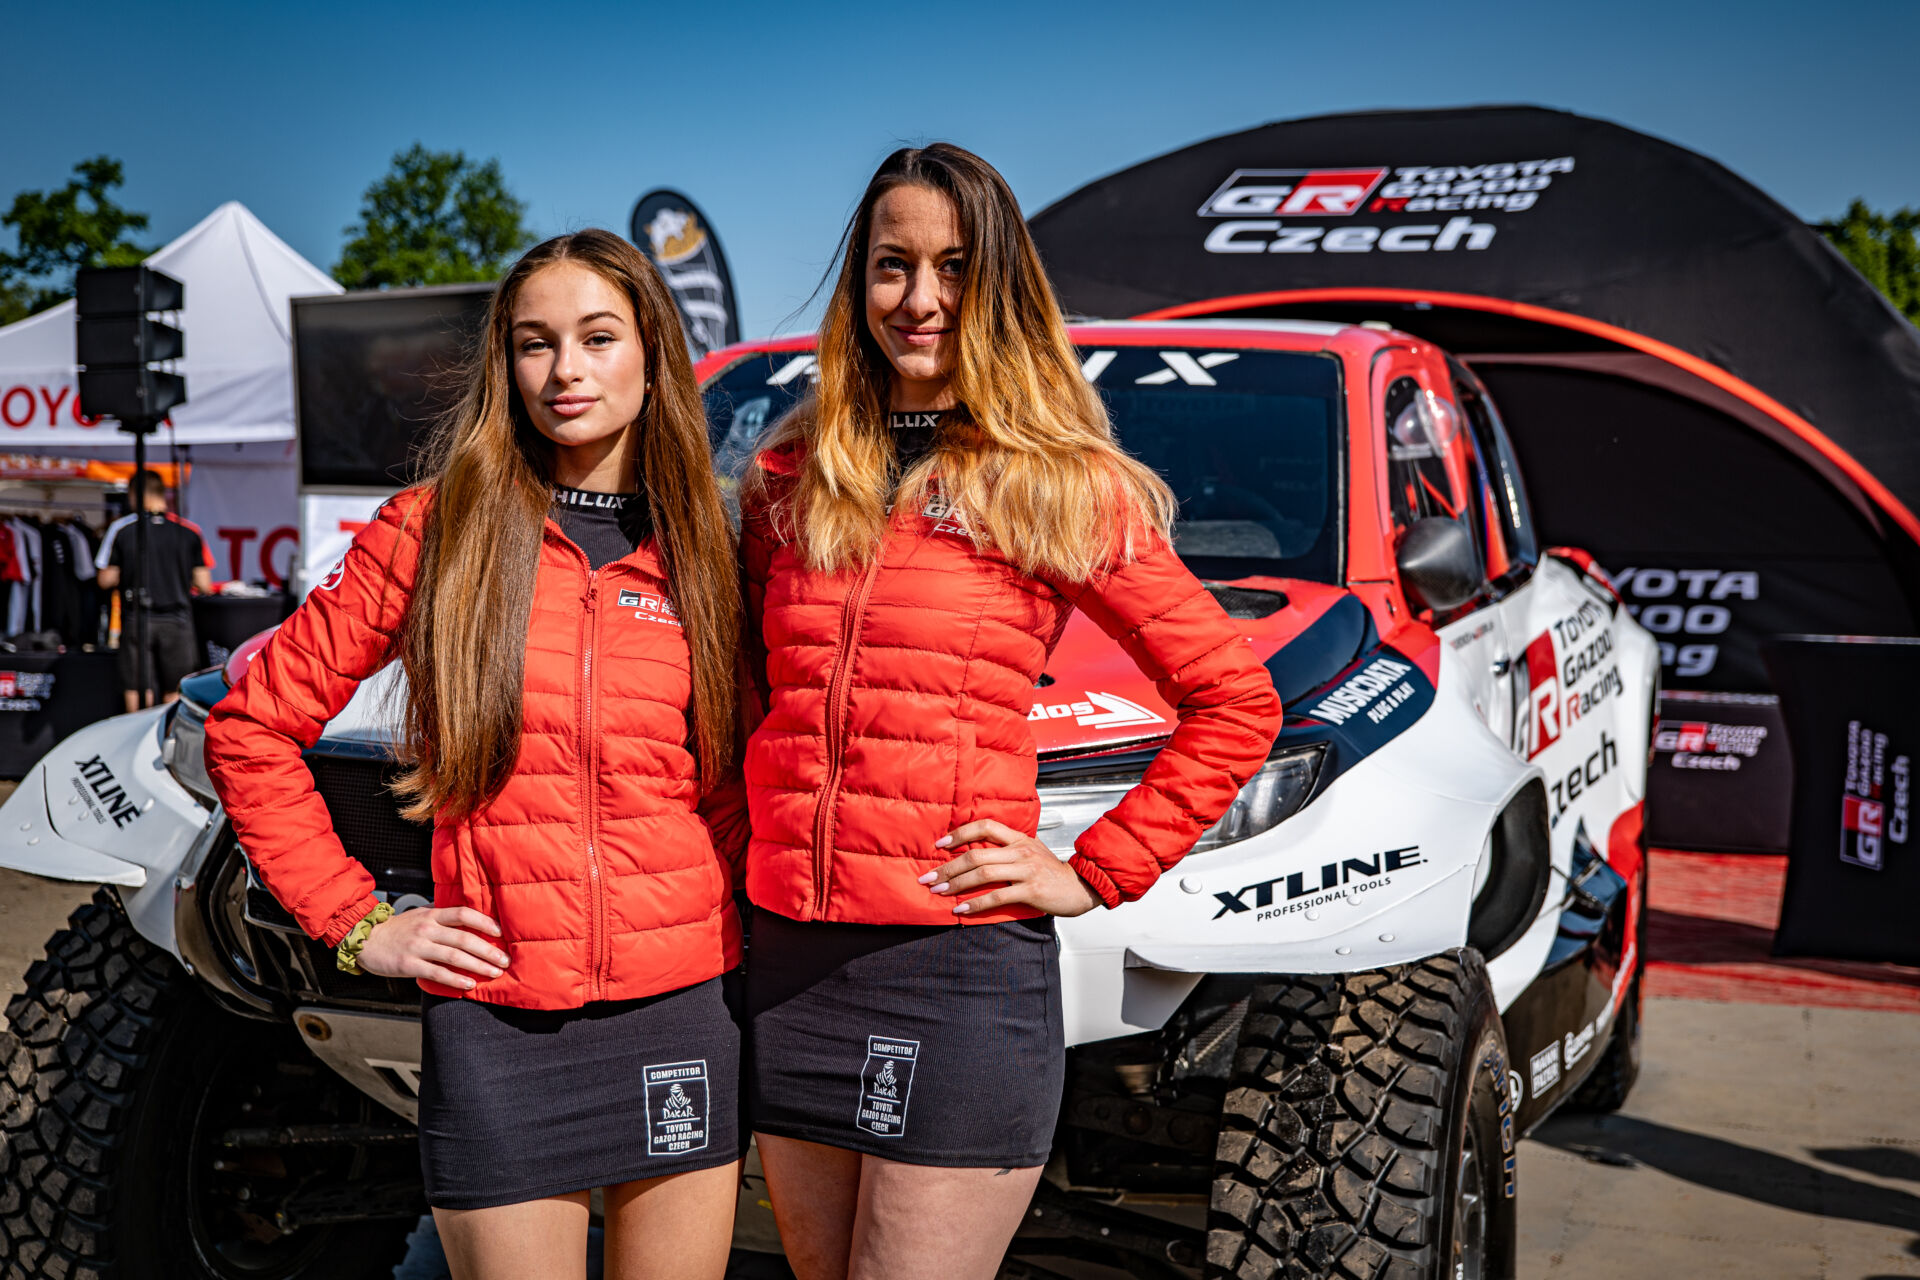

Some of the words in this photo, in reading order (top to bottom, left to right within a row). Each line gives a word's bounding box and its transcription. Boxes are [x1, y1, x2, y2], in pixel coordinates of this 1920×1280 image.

[1395, 156, 1575, 183] TOYOTA
[1380, 175, 1551, 198] GAZOO
[1208, 181, 1368, 215] GR
[1370, 190, 1539, 212] Racing
[1204, 217, 1496, 253] Czech
[552, 489, 627, 509] HILUX
[619, 594, 659, 611] GR
[1309, 658, 1412, 726] MUSICDATA
[1567, 664, 1623, 728] Racing
[1551, 731, 1618, 829] zech
[1256, 889, 1348, 922] PROFESSIONAL
[1352, 876, 1392, 895] TOOLS
[872, 1042, 913, 1056] COMPETITOR
[650, 1066, 701, 1080] COMPETITOR
[861, 1109, 880, 1120] GAZOO
[879, 1112, 901, 1124] RACING
[872, 1101, 893, 1113] TOYOTA
[653, 1134, 677, 1144] GAZOO
[677, 1130, 704, 1141] RACING
[665, 1122, 692, 1134] TOYOTA
[871, 1121, 889, 1133] CZECH
[668, 1141, 690, 1151] CZECH
